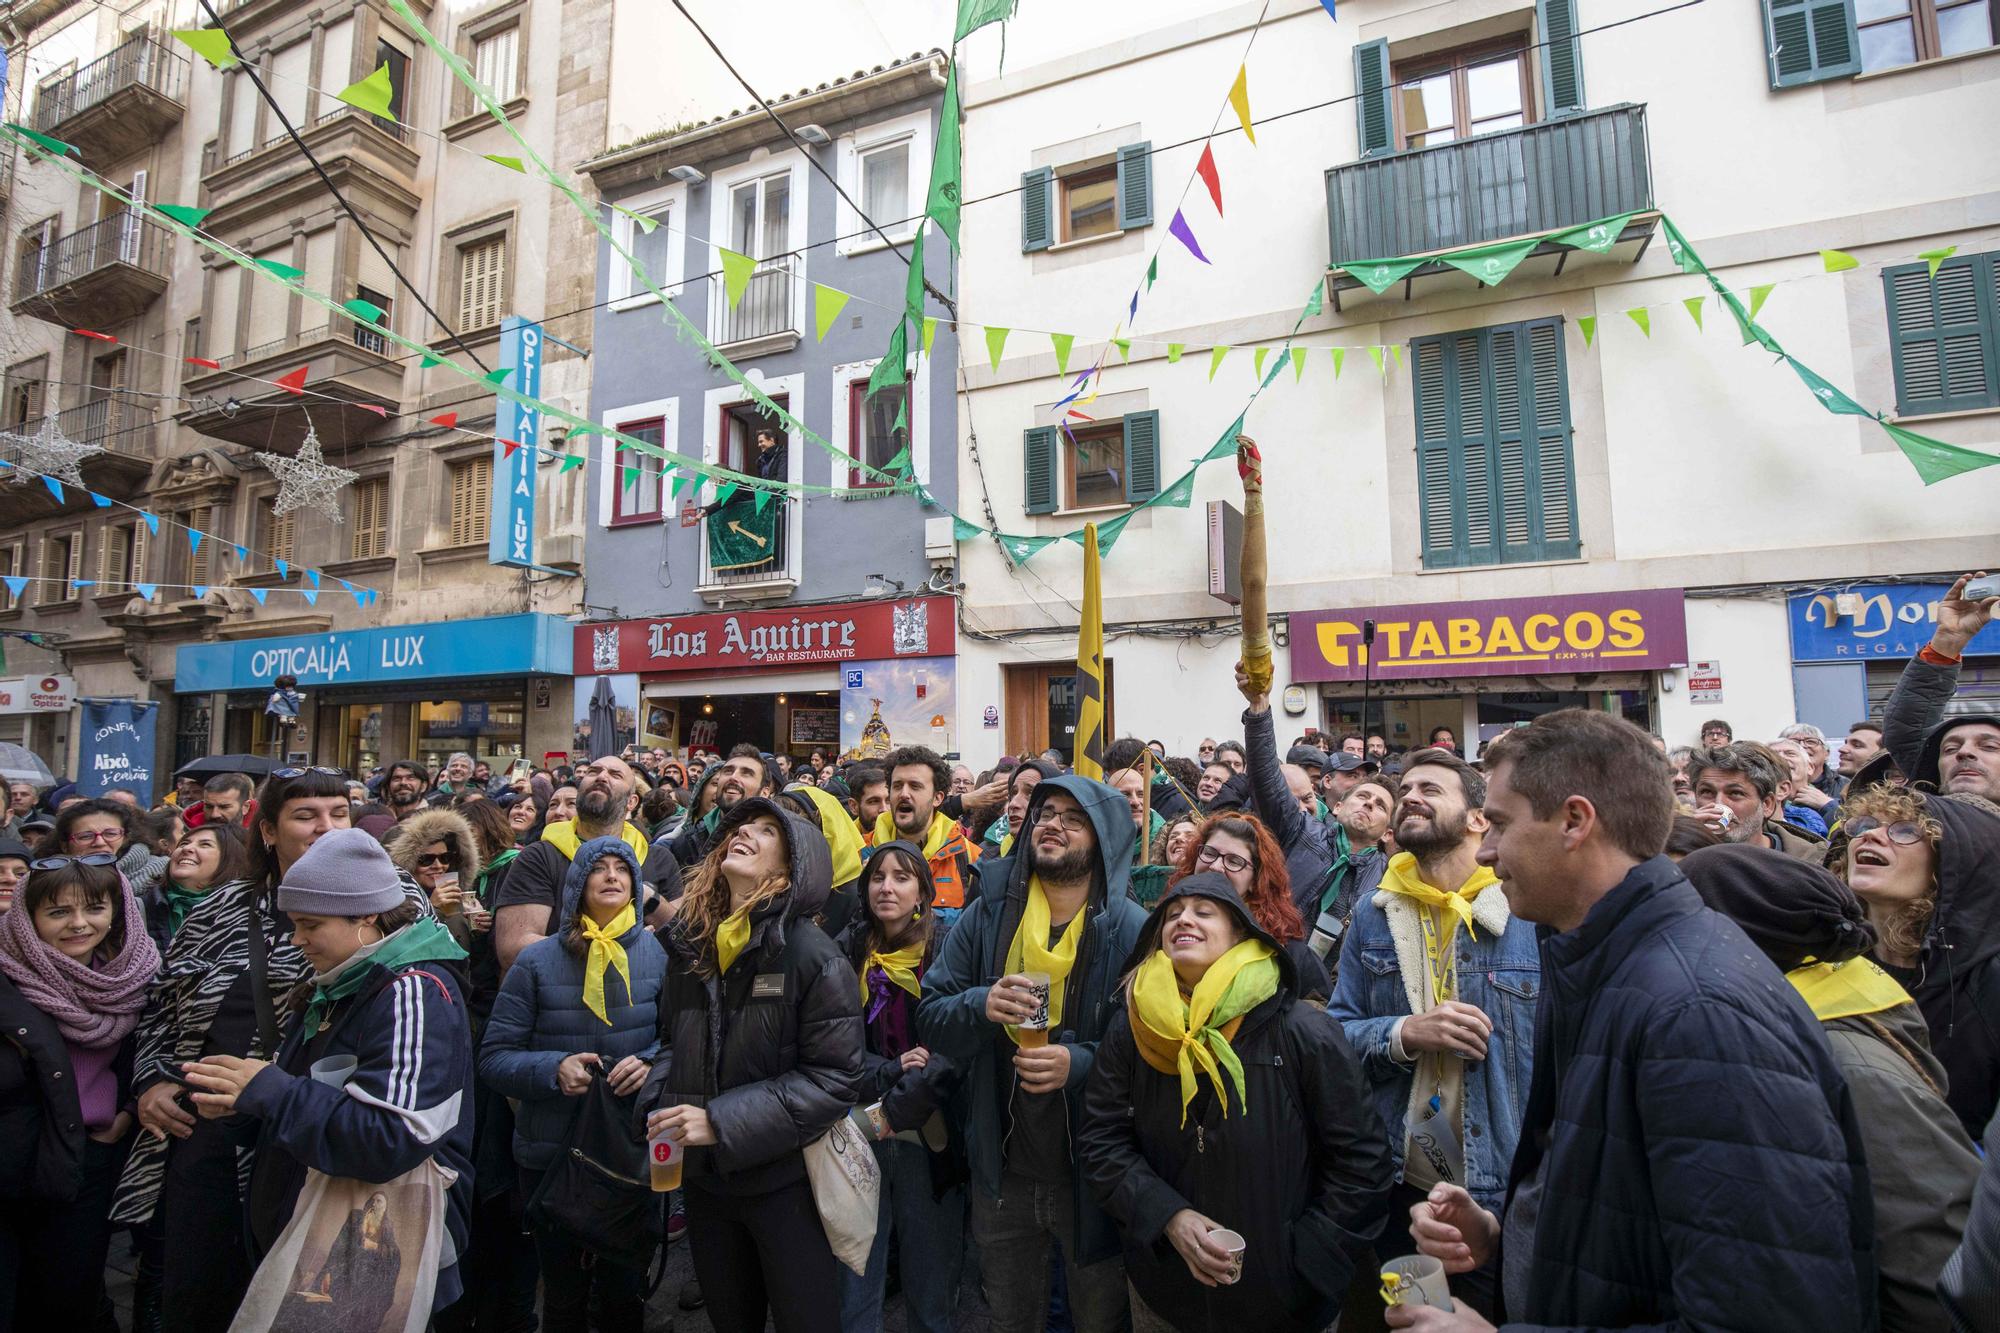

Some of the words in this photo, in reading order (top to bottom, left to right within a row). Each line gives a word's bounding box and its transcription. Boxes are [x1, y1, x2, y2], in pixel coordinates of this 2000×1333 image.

[513, 507, 528, 560] LUX
[647, 621, 708, 659] Los
[718, 616, 856, 661] Aguirre
[1377, 609, 1645, 659] TABACOS
[381, 635, 425, 668] LUX
[766, 653, 785, 662] BAR
[787, 648, 856, 661] RESTAURANTE
[30, 692, 67, 701] General
[33, 700, 64, 709] Optica
[94, 752, 130, 770] Això
